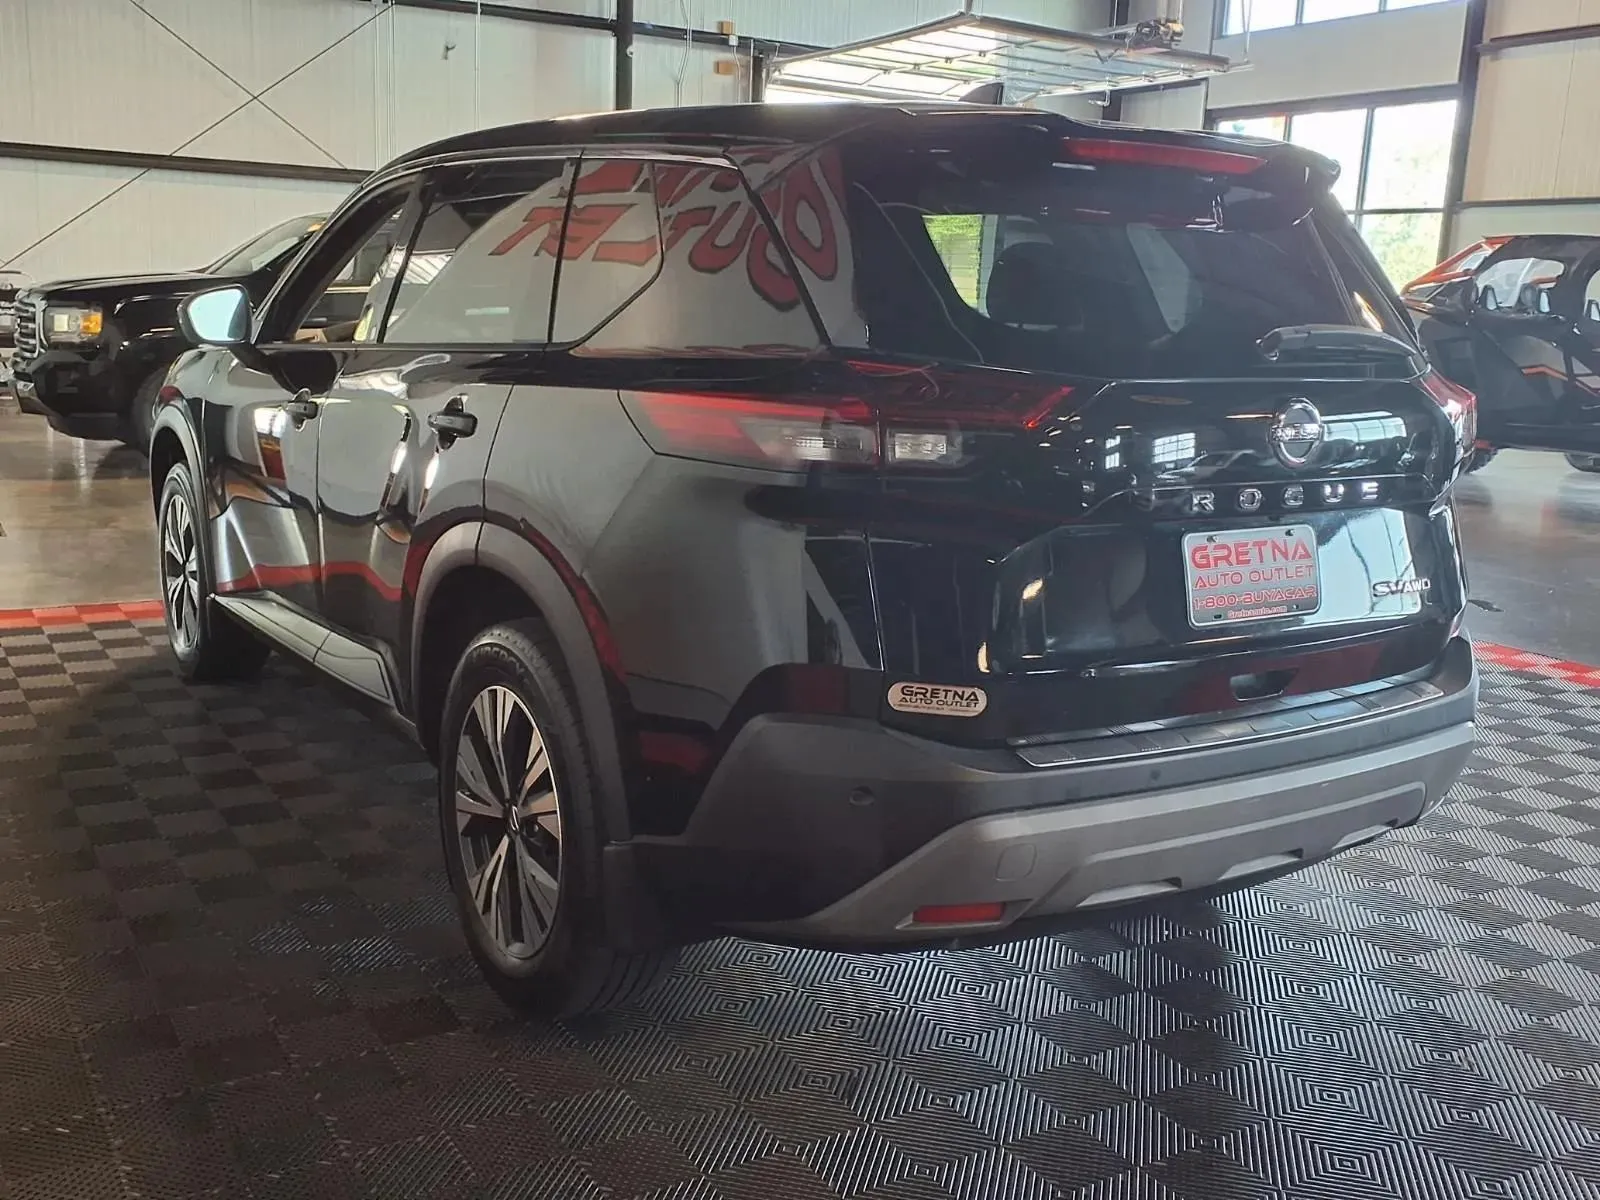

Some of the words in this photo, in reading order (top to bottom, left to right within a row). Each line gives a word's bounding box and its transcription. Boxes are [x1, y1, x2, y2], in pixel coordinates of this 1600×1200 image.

[1190, 481, 1380, 513] ROGUE
[1191, 539, 1313, 570] GRETNA
[1194, 571, 1243, 589] AUTO
[1249, 564, 1314, 583] OUTLET
[1403, 578, 1431, 593] AWD
[1193, 585, 1318, 610] 1-800-BUYACAR
[899, 697, 933, 705] AUTO
[936, 700, 979, 708] OUTLET
[900, 685, 980, 702] GRETNA
